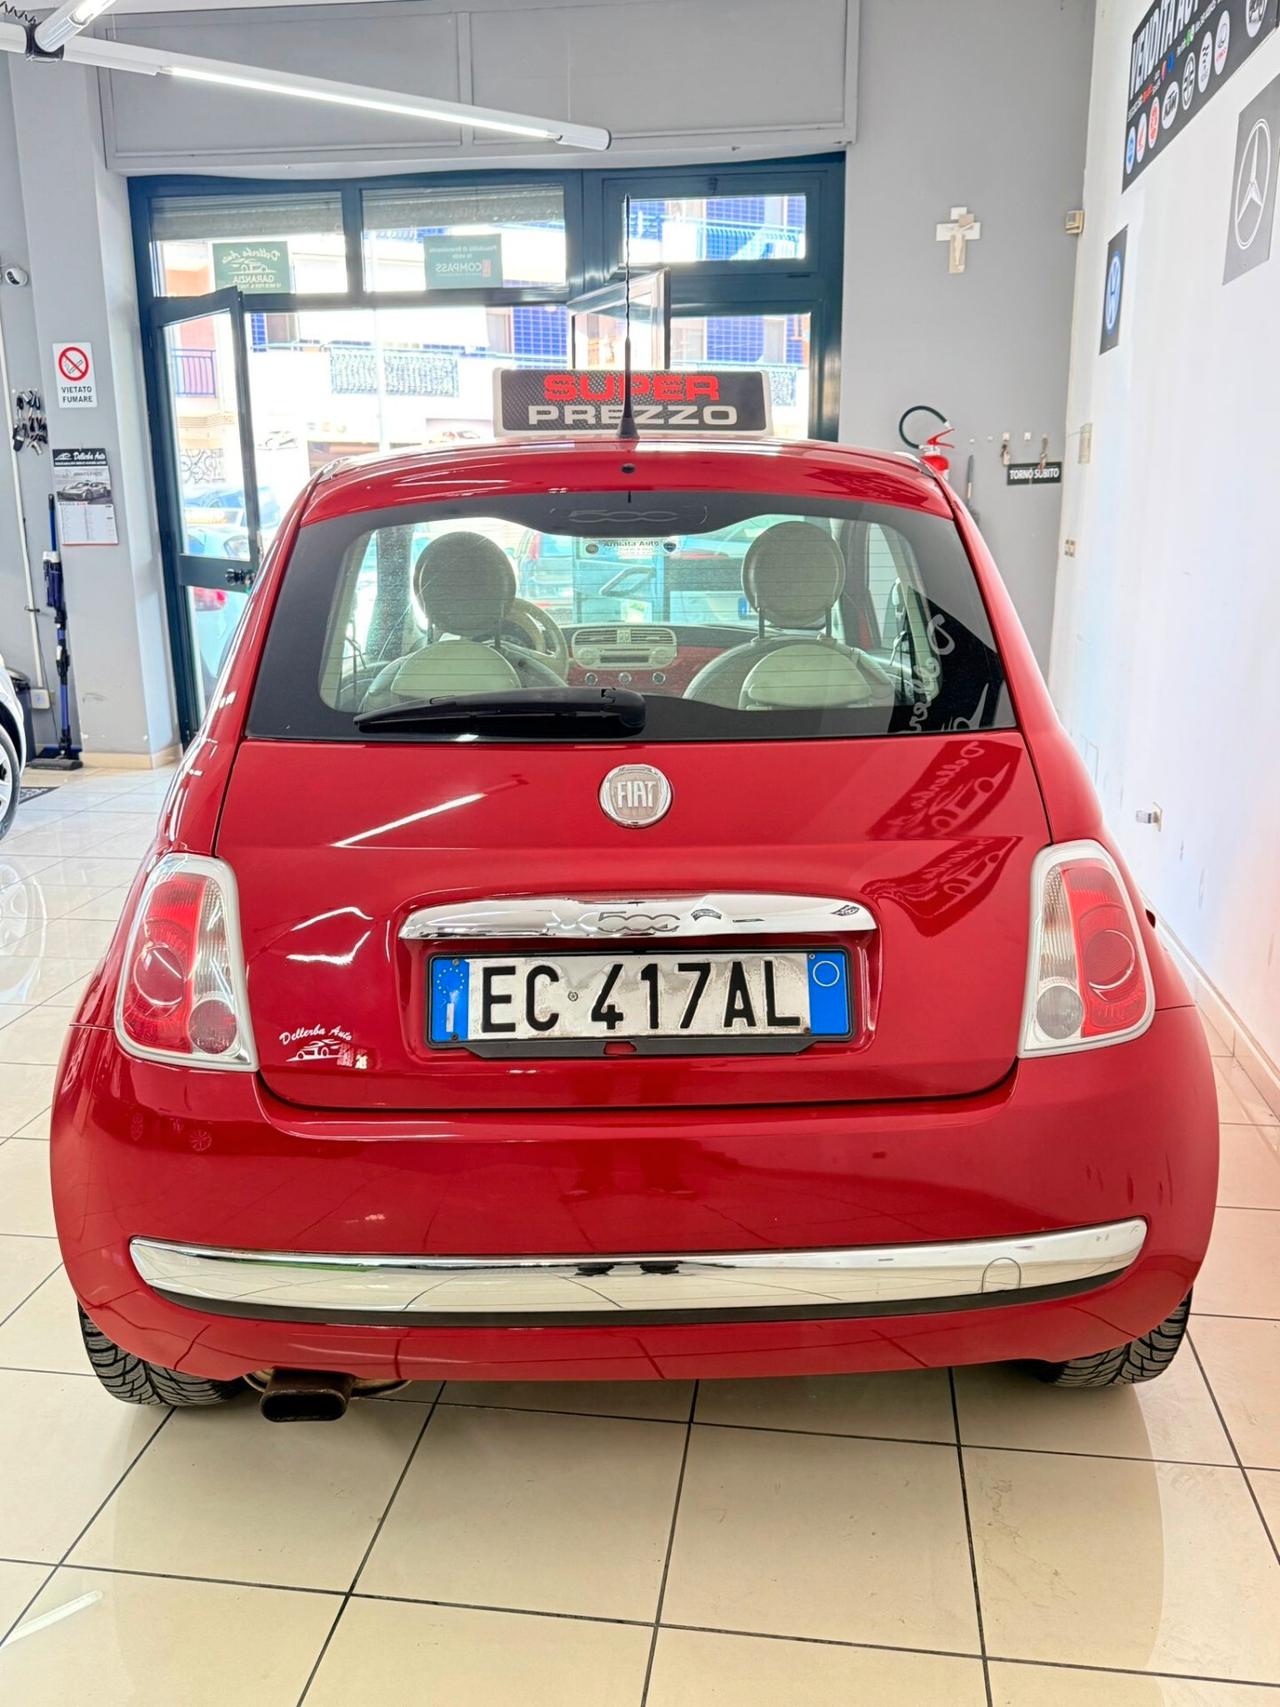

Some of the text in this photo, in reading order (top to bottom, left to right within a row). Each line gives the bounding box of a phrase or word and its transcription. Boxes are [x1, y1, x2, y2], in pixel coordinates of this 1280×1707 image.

[61, 385, 92, 394] VIETATO
[543, 373, 720, 402] SUPER
[62, 395, 93, 404] FUMARE
[528, 405, 738, 426] PREZZO
[1009, 467, 1060, 480] TORNO SUBITO
[617, 779, 657, 808] FIAT
[597, 910, 681, 933] 500
[482, 960, 801, 1033] EC 417AL
[278, 1023, 353, 1046] Dellerba Auto
